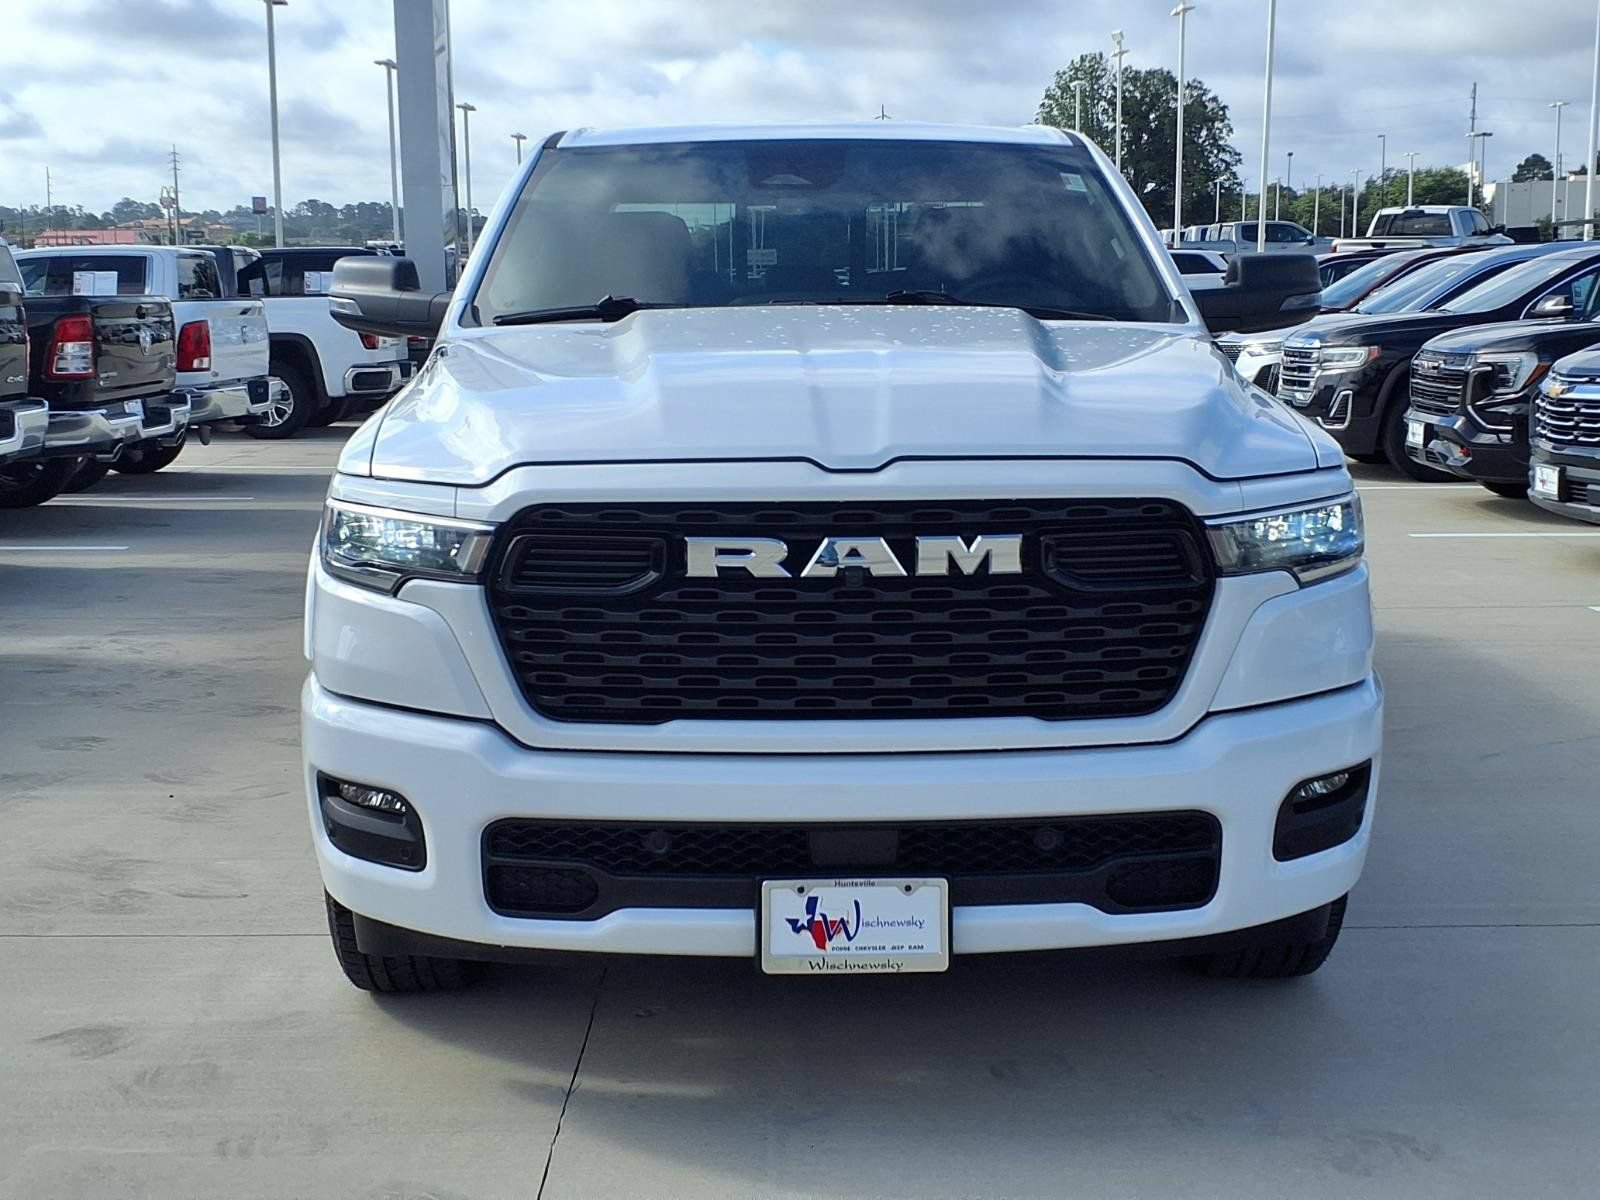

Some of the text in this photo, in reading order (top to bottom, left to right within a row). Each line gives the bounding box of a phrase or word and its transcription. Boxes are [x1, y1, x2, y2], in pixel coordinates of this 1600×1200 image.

[684, 534, 1023, 577] RAM
[834, 879, 876, 888] Huntsville
[819, 899, 926, 943] Wischnewsky
[808, 957, 904, 973] Wischnewsky
